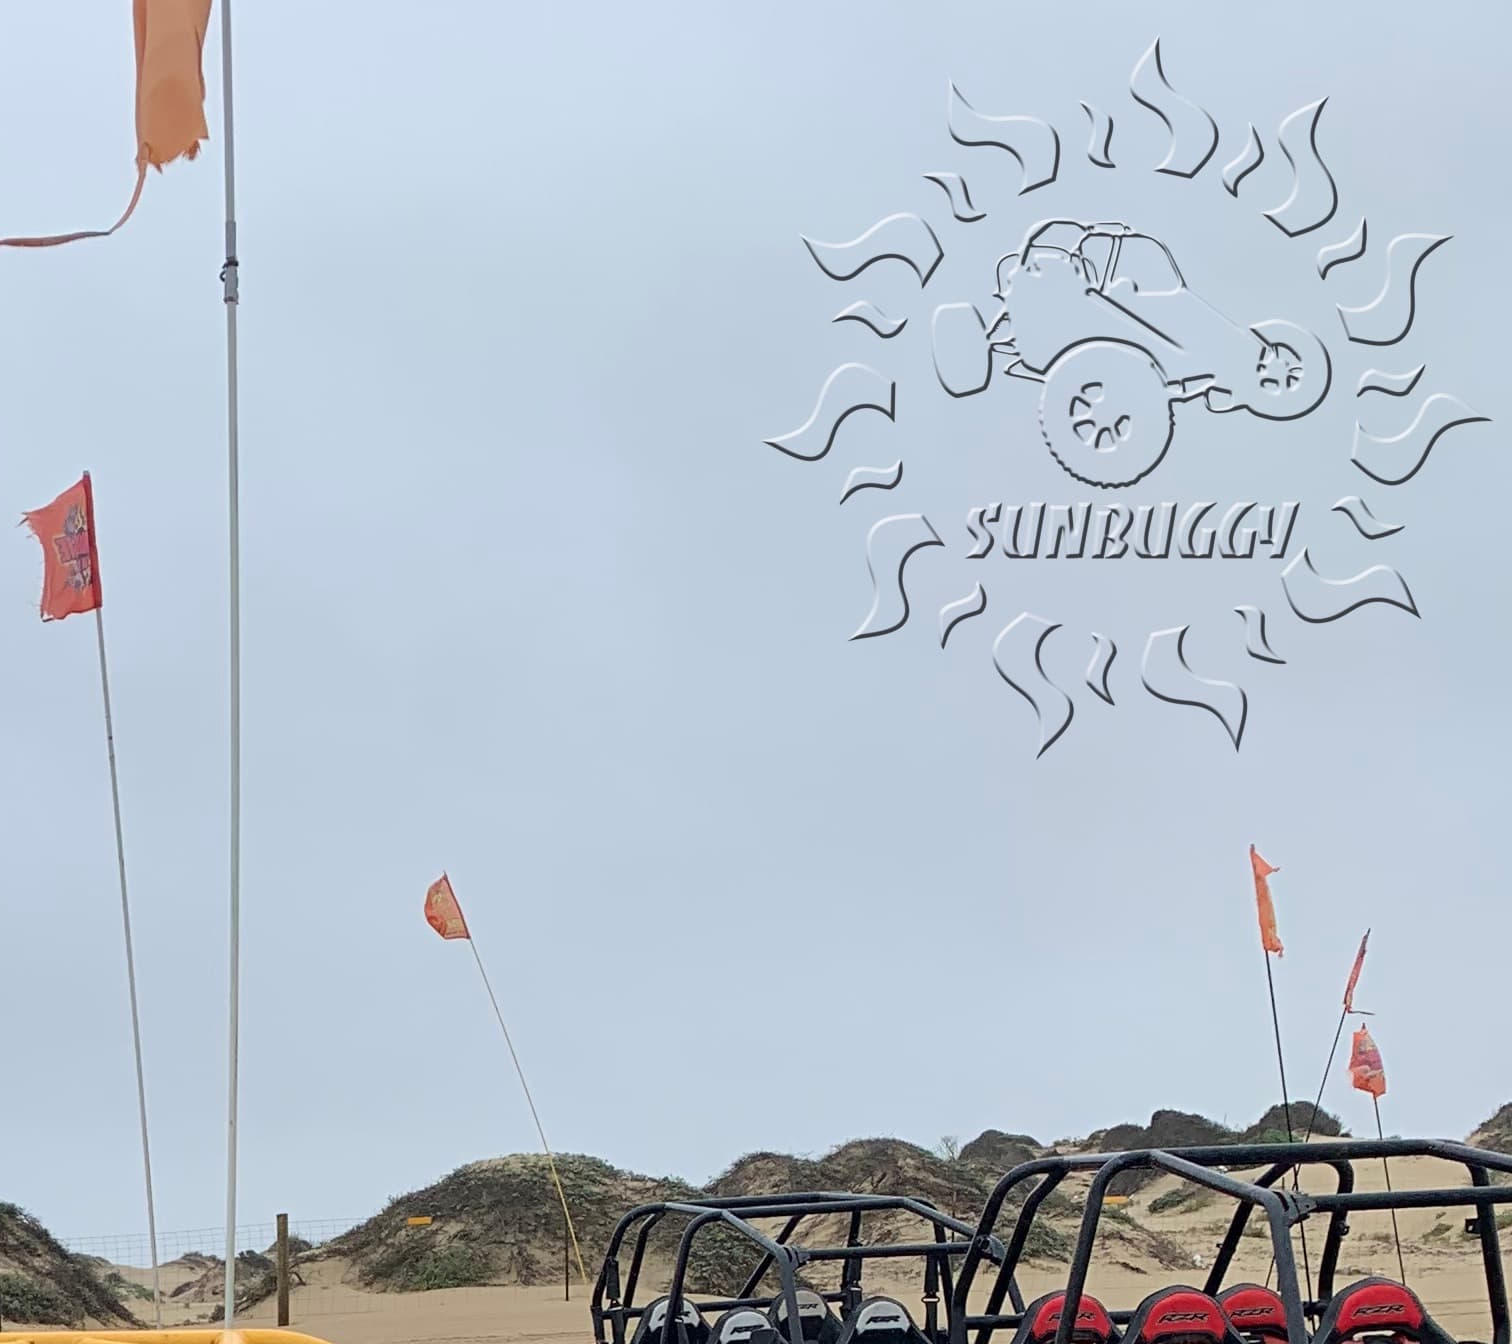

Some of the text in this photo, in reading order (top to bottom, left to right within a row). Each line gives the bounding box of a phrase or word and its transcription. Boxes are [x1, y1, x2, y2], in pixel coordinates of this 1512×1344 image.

[1048, 1312, 1095, 1321] RR
[1230, 1306, 1274, 1319] RZR
[1352, 1304, 1404, 1317] RZR
[1158, 1312, 1209, 1323] RZR
